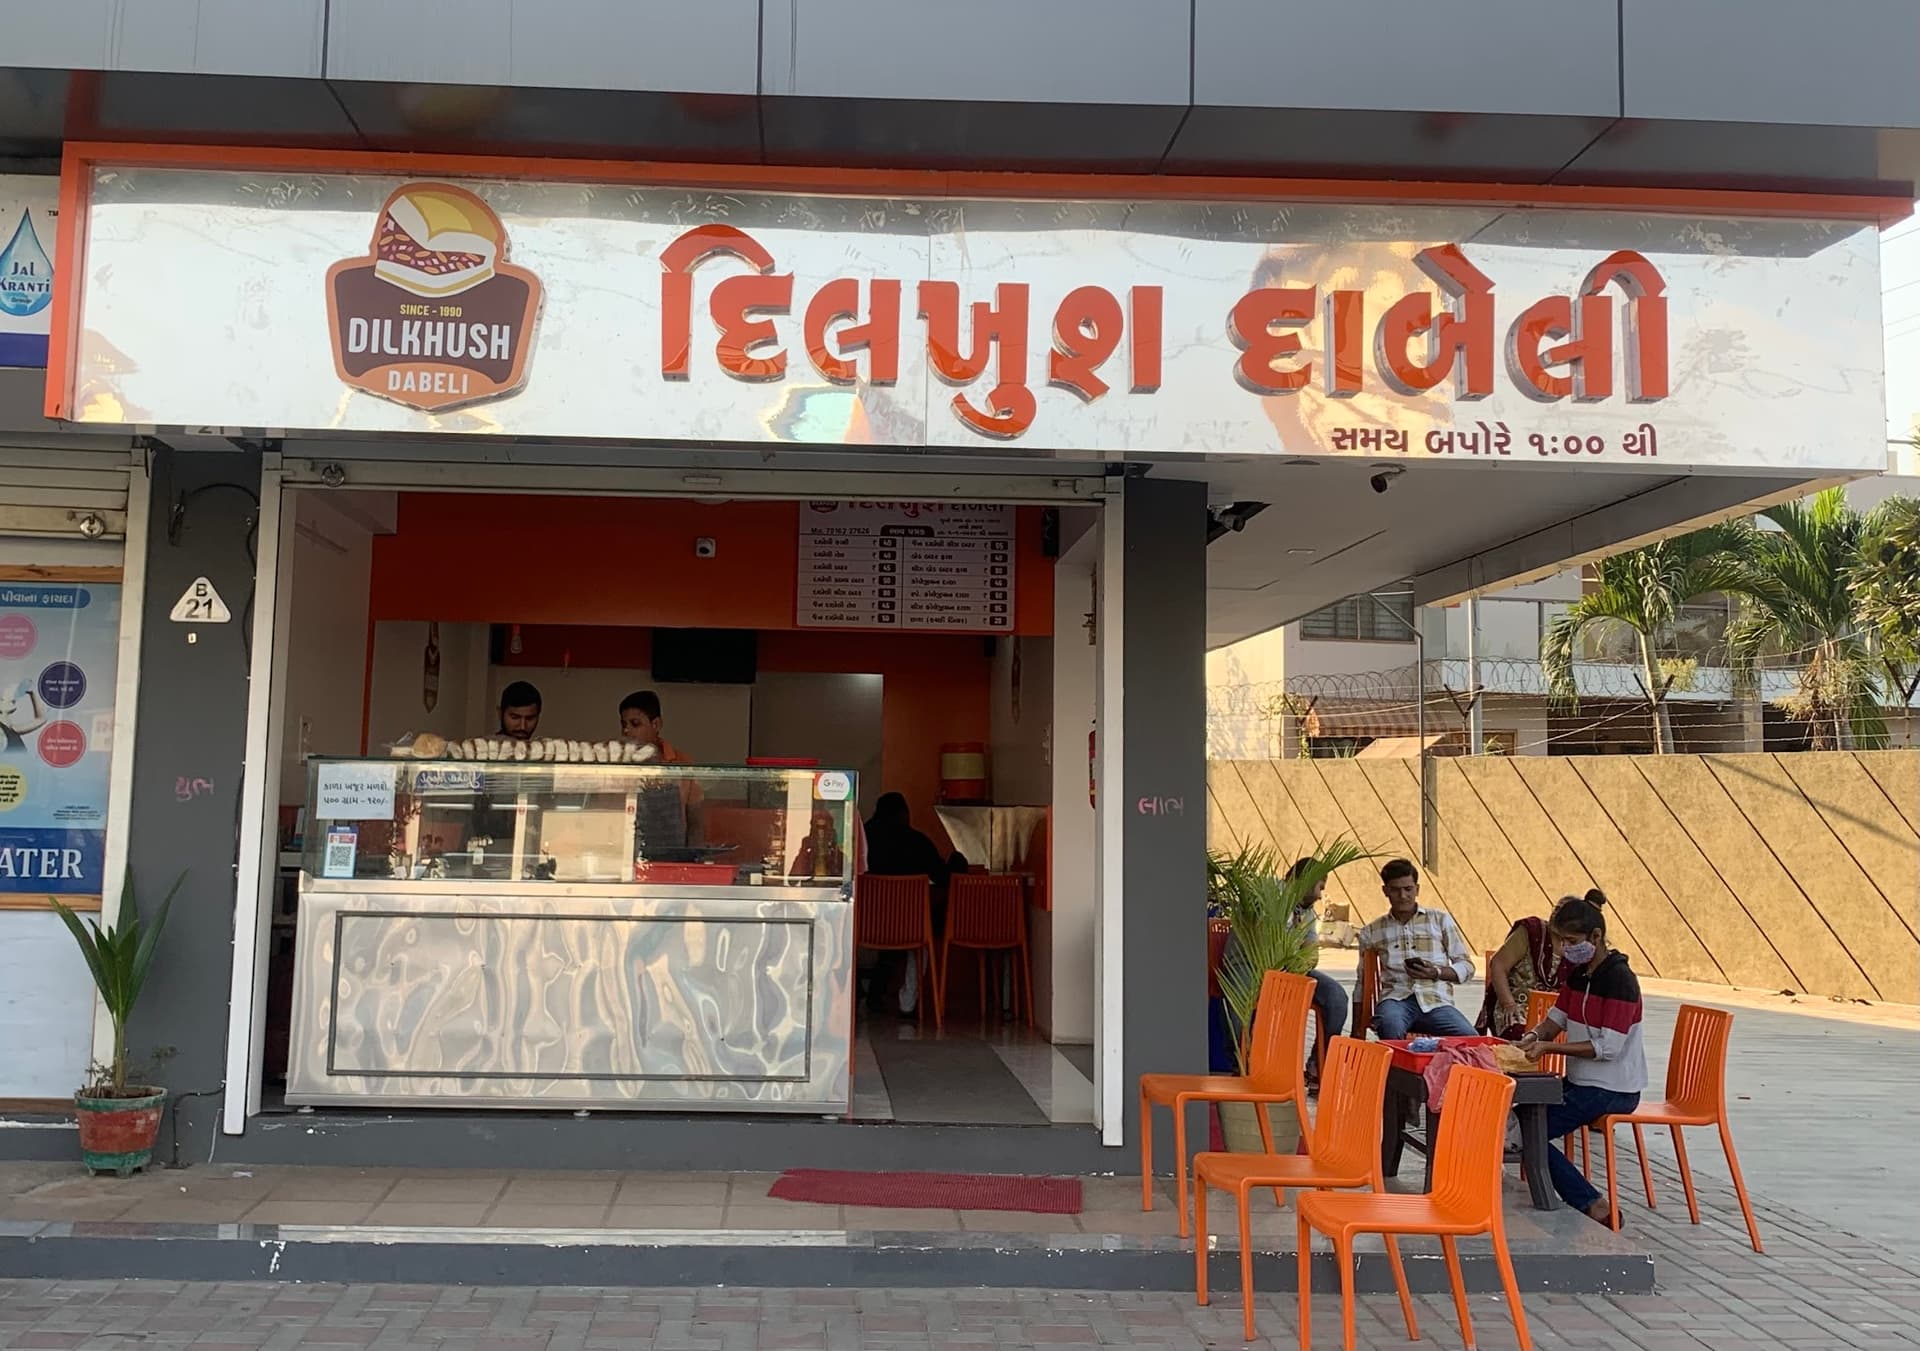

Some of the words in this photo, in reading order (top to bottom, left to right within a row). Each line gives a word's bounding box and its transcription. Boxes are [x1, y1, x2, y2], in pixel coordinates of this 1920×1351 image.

[399, 303, 430, 316] SINCE
[439, 305, 463, 318] 1990
[347, 316, 511, 361] DILKHUSH
[659, 223, 1164, 440] દિલખુશ
[1225, 242, 1670, 404] દાબેલી
[387, 370, 468, 395] DABELI
[1331, 426, 1409, 453] સમય
[1424, 421, 1512, 456] બપોરે
[1622, 422, 1658, 457] થી
[195, 583, 209, 598] B
[184, 597, 214, 620] 21
